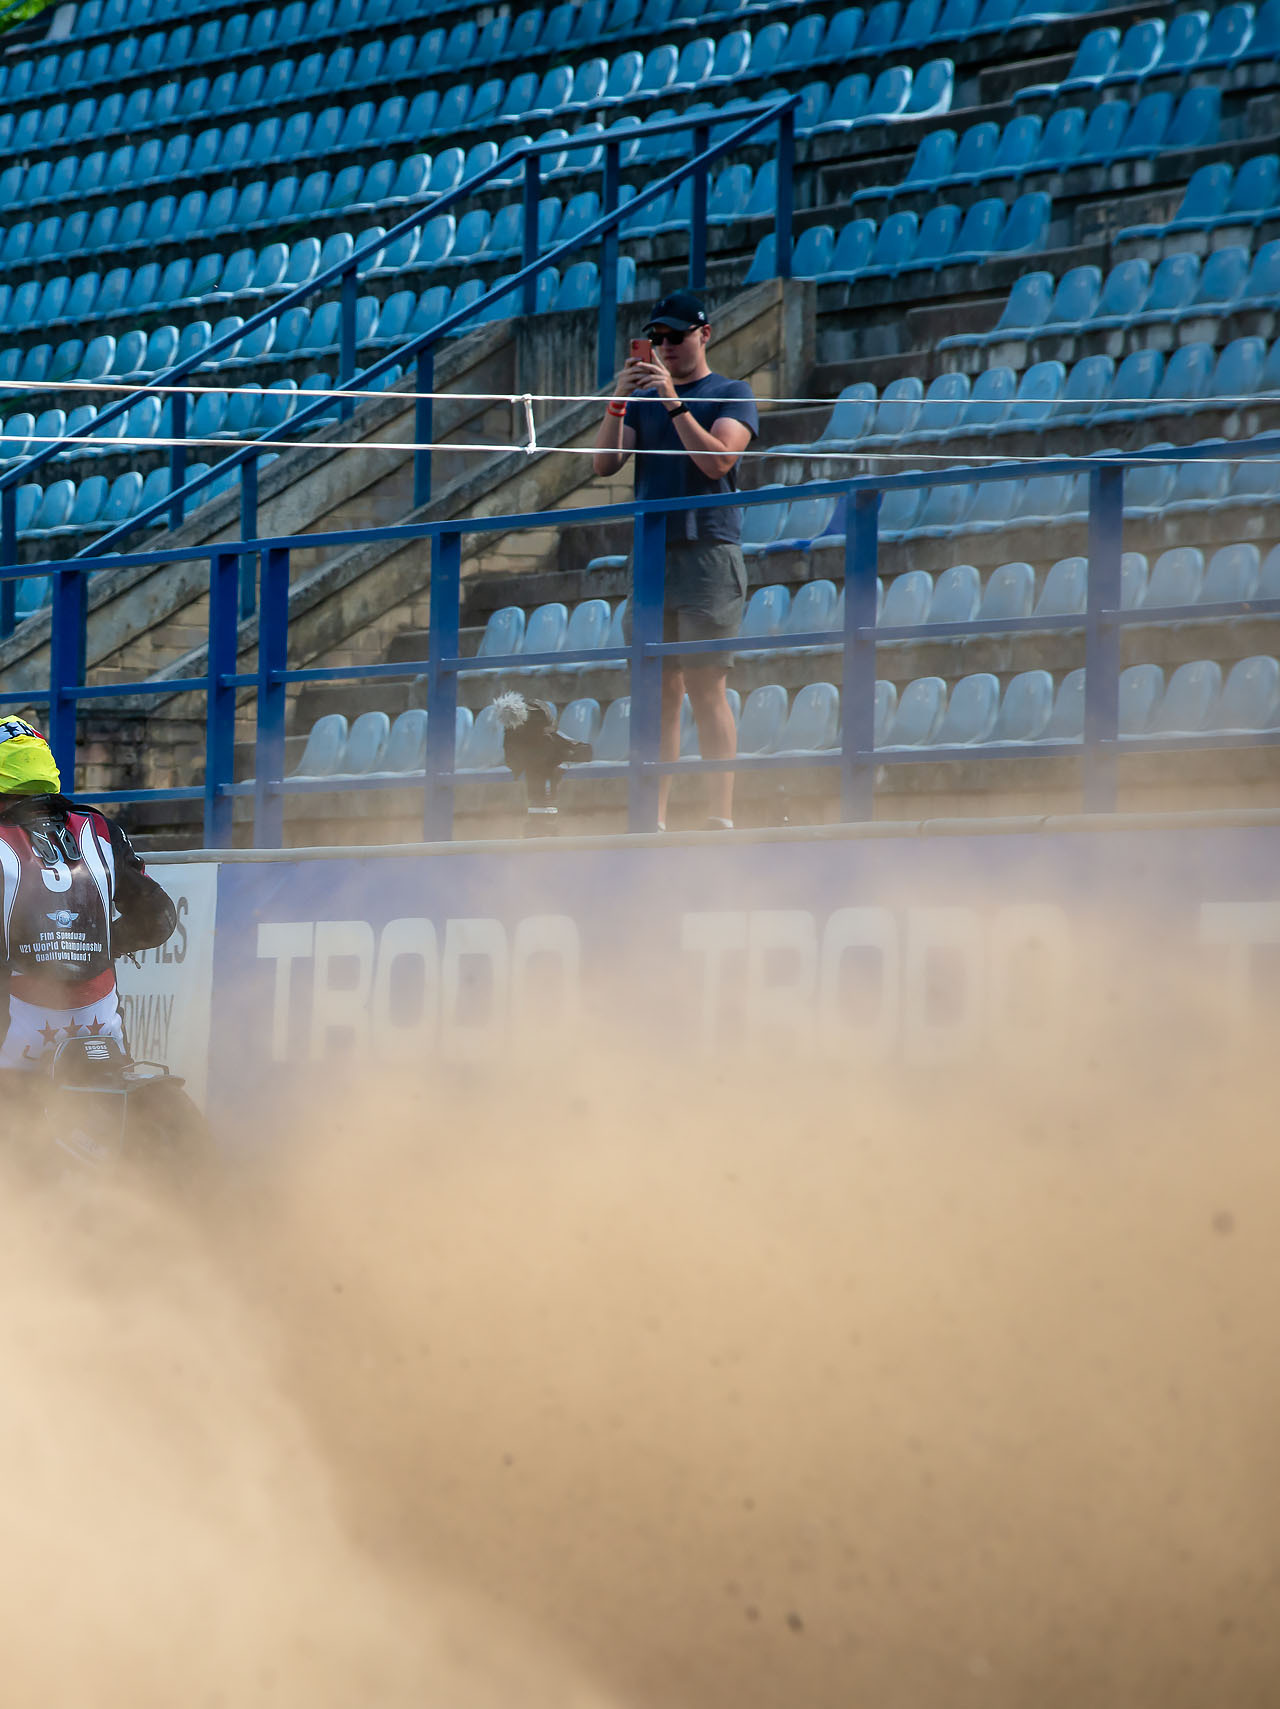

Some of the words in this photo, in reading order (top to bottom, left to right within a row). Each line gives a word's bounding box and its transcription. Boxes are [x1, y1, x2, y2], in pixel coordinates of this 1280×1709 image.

[40, 932, 55, 941] FIM
[56, 931, 86, 941] Speedway
[33, 941, 59, 952] World
[61, 940, 102, 952] Championship
[36, 952, 70, 962] Qualifying
[255, 914, 583, 1064] TRODO
[681, 904, 1070, 1067] TRODO
